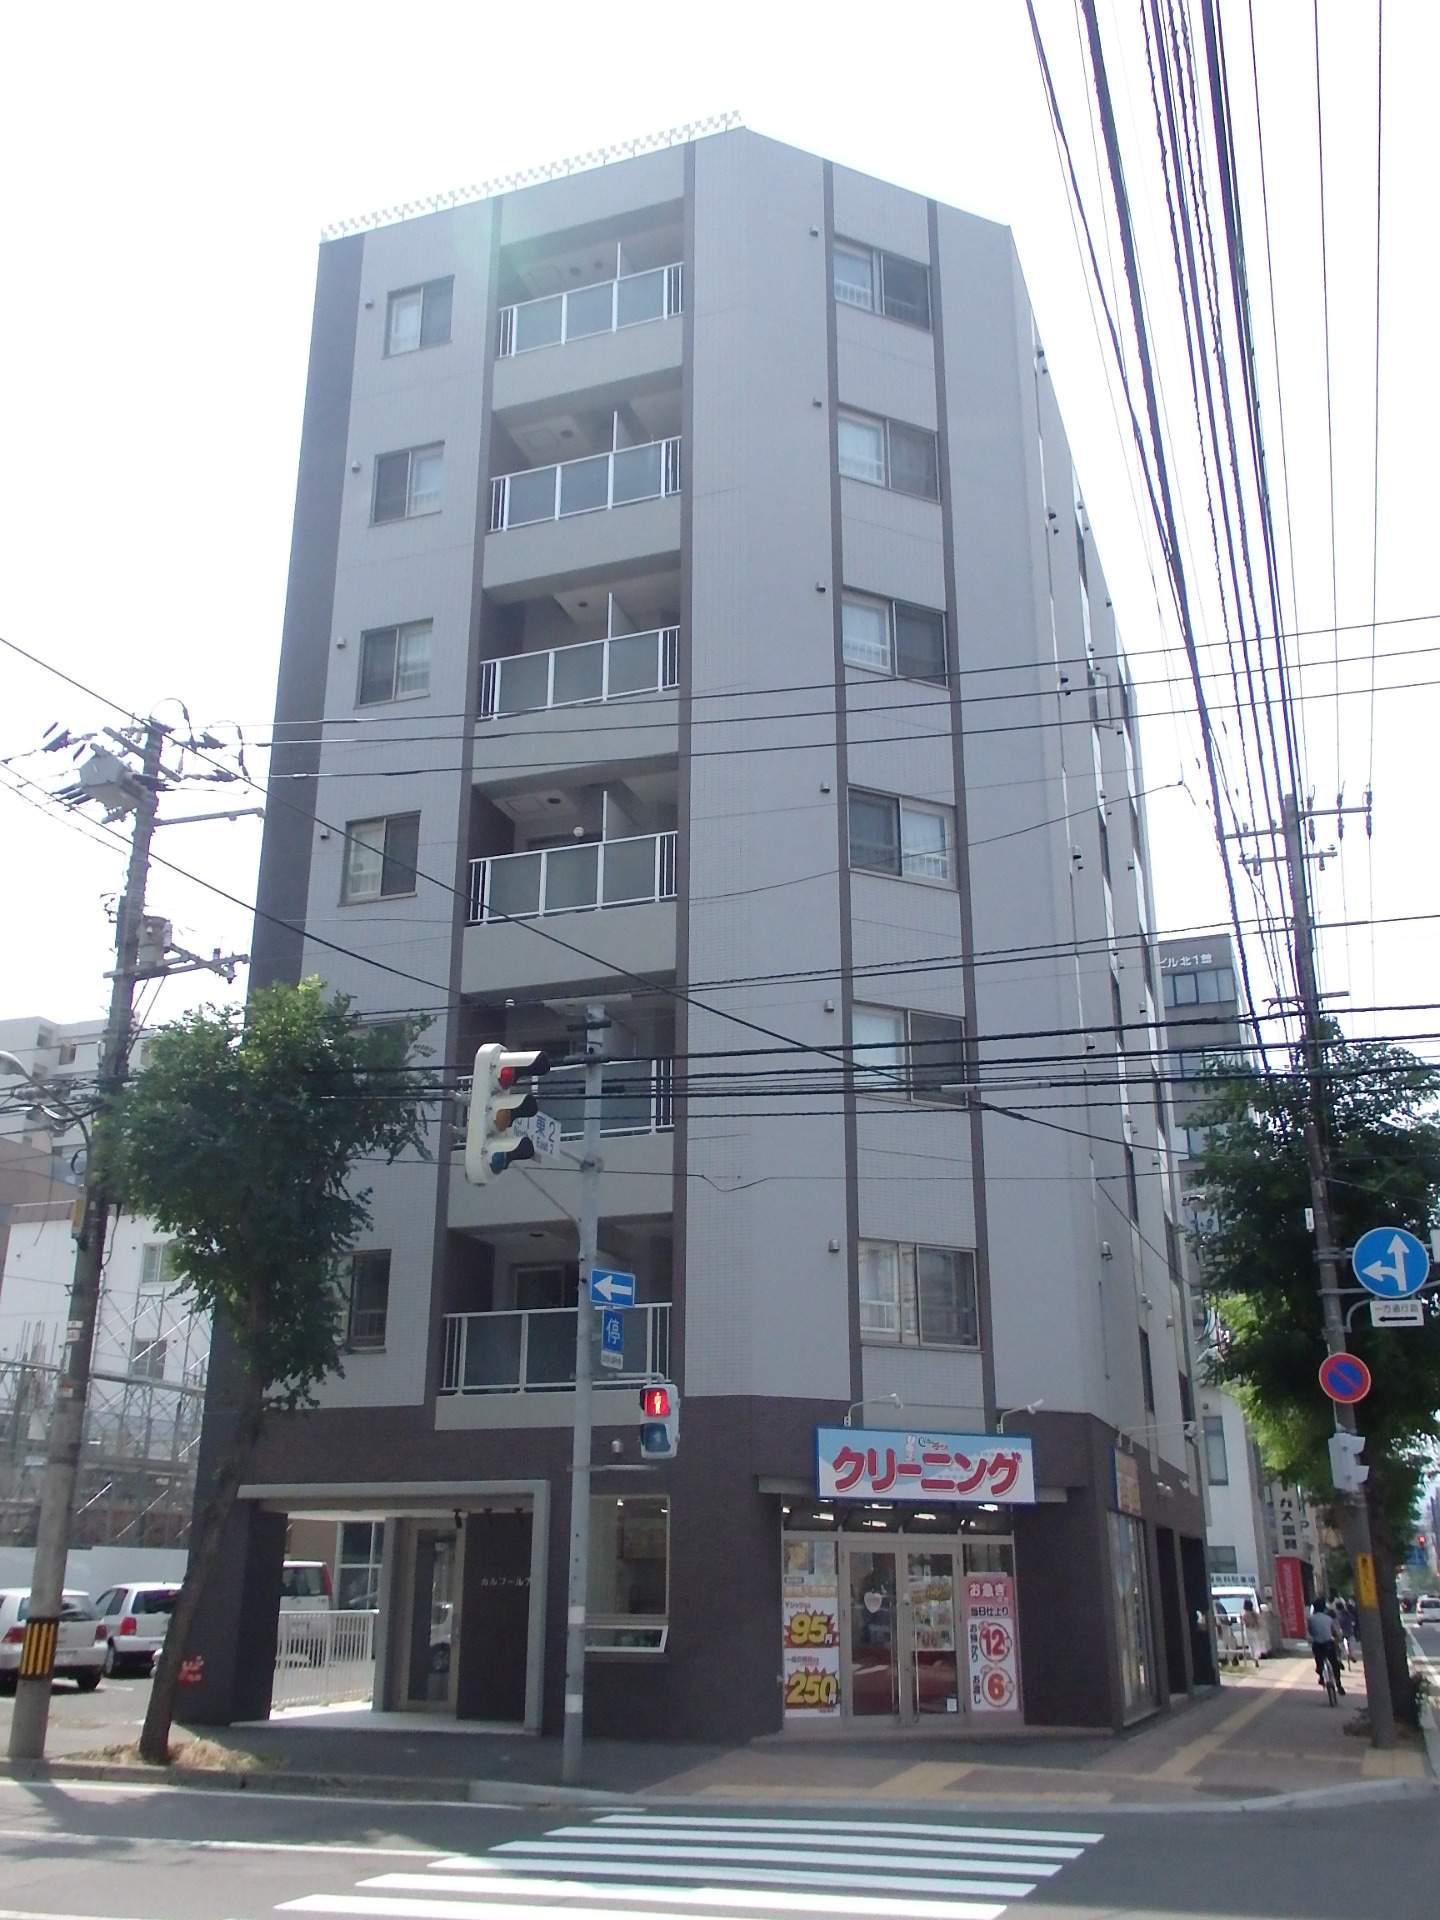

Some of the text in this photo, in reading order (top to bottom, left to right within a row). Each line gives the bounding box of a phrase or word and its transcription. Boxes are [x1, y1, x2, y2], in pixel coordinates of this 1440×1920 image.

[606, 1317, 621, 1345] 停
[832, 1446, 1022, 1498] クリーニング
[981, 1628, 1006, 1656] 12
[987, 1672, 1004, 1700] 6
